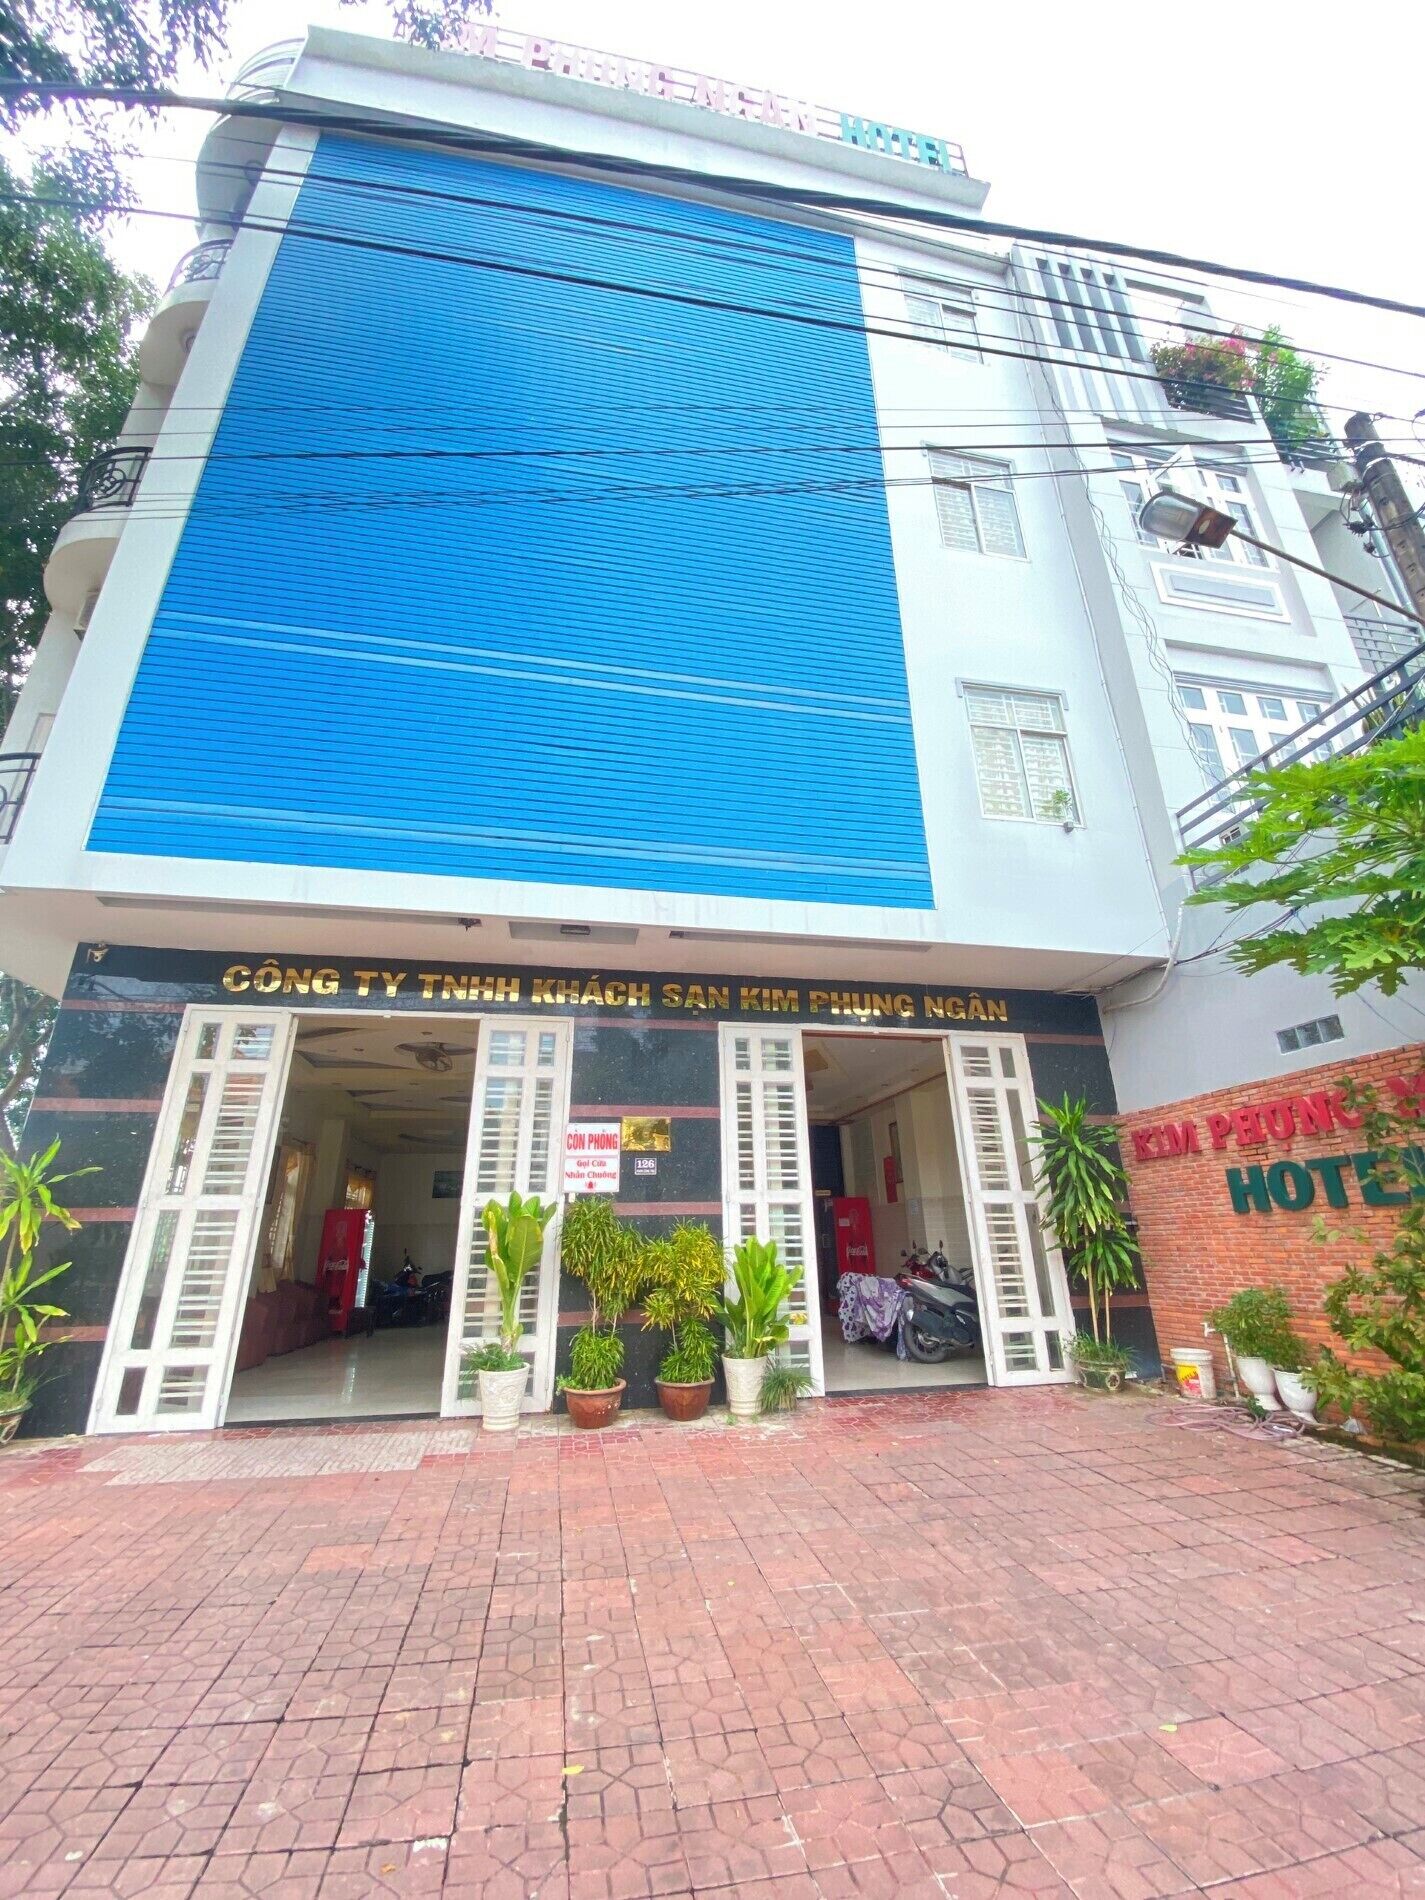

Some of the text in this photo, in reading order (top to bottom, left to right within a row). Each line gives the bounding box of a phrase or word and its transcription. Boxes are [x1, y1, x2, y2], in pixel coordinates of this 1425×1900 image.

[839, 112, 952, 173] HOTEL
[222, 958, 1008, 1022] CÔNG TY TNHH KHÁCH SẠN KIM PHỤNG NGÂN
[636, 1159, 655, 1168] 126
[1131, 1119, 1200, 1162] KIM
